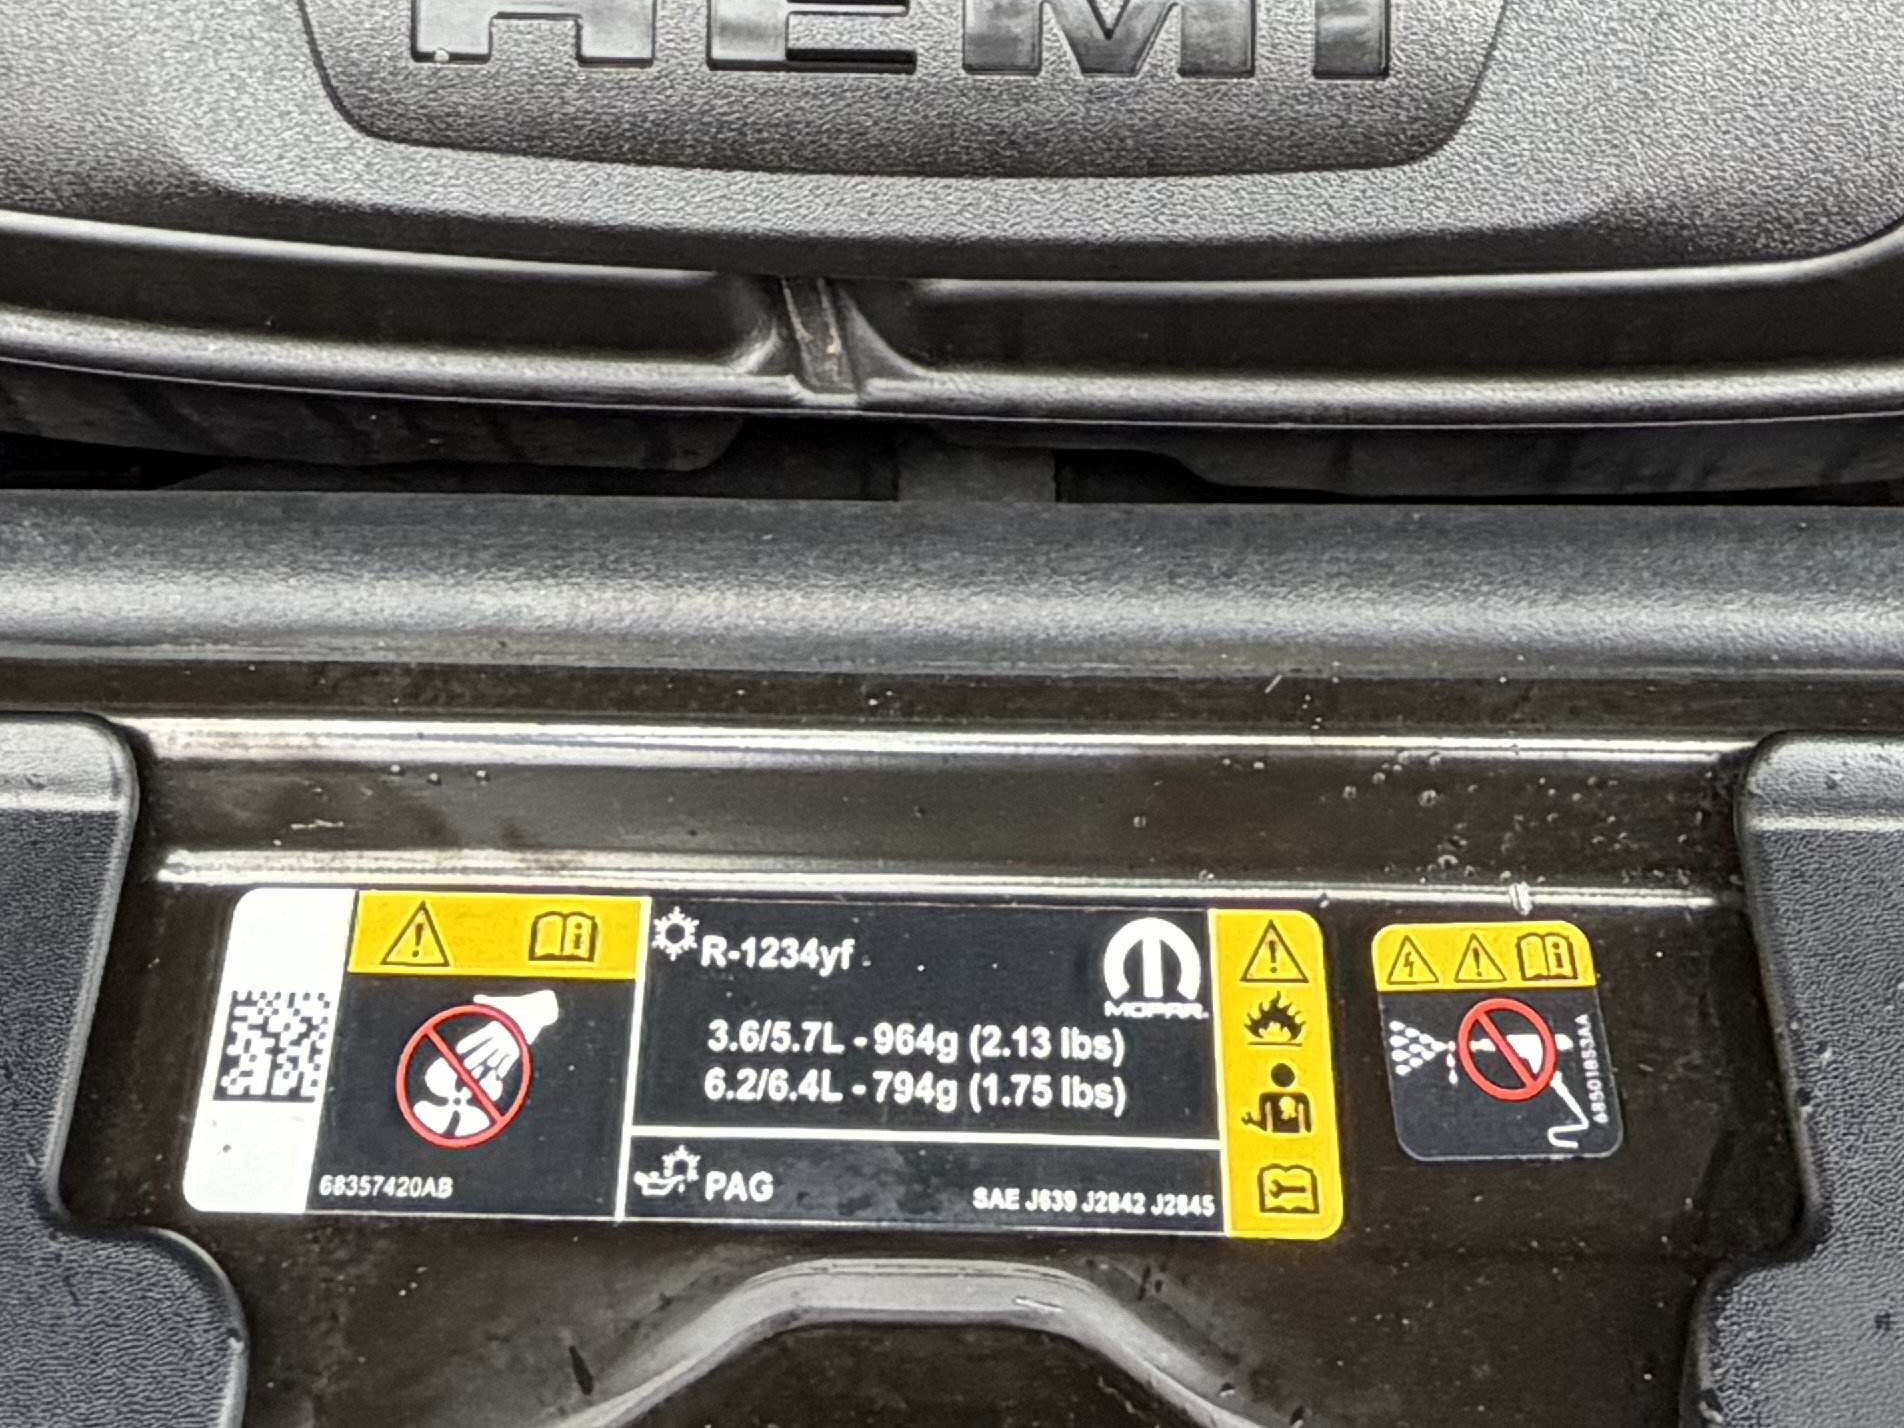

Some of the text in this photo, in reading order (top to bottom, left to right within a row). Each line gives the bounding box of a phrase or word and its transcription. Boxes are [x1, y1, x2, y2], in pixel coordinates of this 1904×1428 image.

[700, 934, 856, 978] R-1234yf
[707, 1018, 846, 1055] 3.6/5.7L
[872, 1021, 959, 1064] 964g
[968, 1023, 1053, 1065] (2.13
[1060, 1026, 1127, 1068] lbs)
[703, 1066, 844, 1103] 6.2/6.4L
[872, 1070, 959, 1114] 794g
[968, 1072, 1054, 1114] (1.75
[1060, 1074, 1128, 1117] lbs)
[318, 1174, 454, 1200] 68357420AB
[704, 1170, 774, 1203] PAG
[972, 1186, 1021, 1212] SAE
[1024, 1188, 1078, 1213] J639
